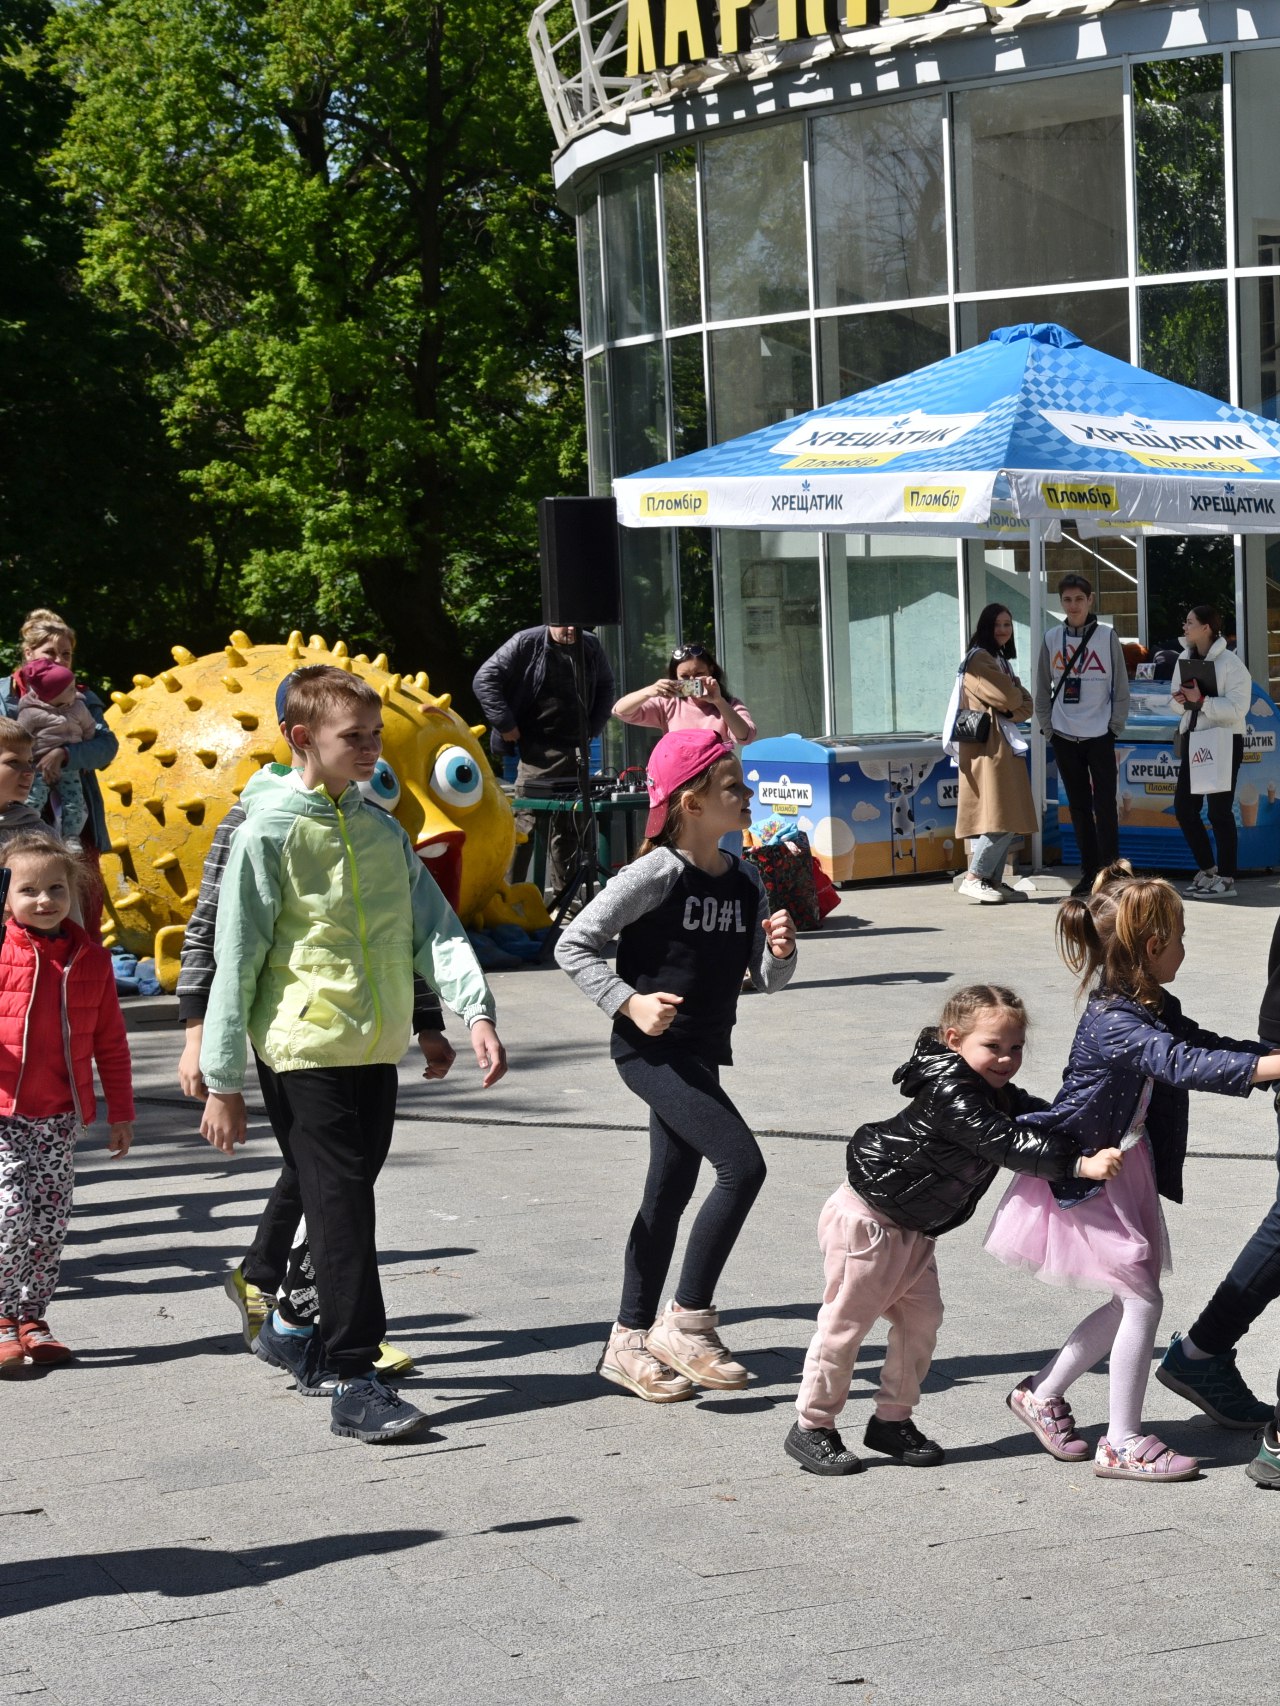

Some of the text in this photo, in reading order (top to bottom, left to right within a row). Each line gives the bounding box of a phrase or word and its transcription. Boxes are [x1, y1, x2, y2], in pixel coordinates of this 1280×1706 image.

[796, 426, 961, 449] ХРЕЩАТИК
[1071, 424, 1258, 452] ХРЕЩАТИК
[795, 457, 878, 468] Пломбір
[1151, 457, 1245, 473] Пломбір
[646, 490, 960, 513] Пломбір ХРЕЩАТИК Пломбір
[1047, 487, 1111, 508] Пломбір
[1191, 495, 1275, 516] ХРЕЩАТИК
[762, 787, 808, 800] ХРЕЩАТИК
